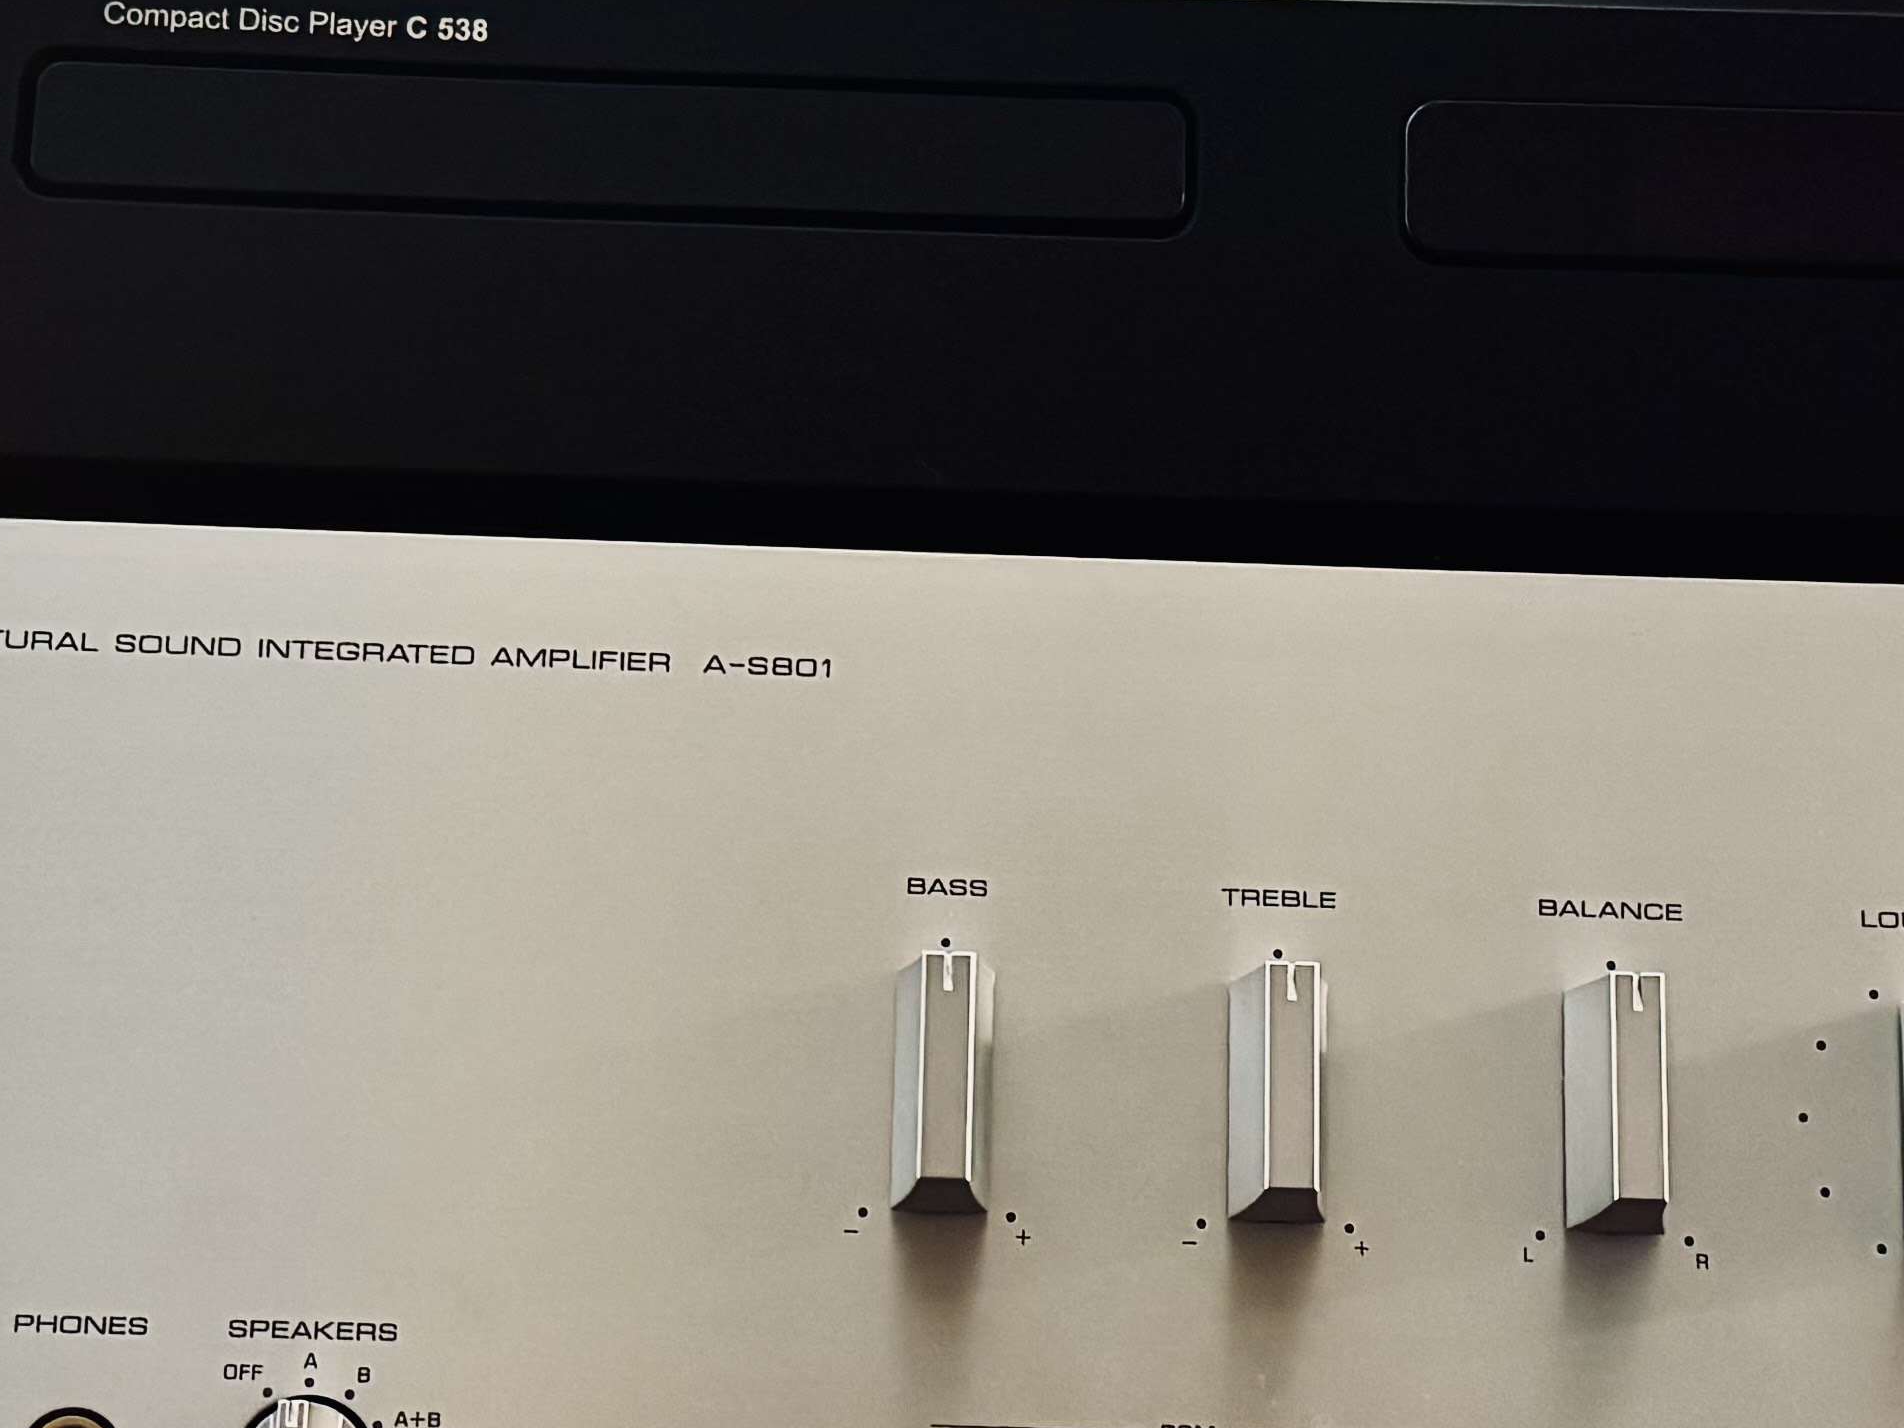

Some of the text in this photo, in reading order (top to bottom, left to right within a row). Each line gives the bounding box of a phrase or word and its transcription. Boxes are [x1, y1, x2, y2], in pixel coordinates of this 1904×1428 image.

[103, 0, 488, 43] Compact Disc Player C 538
[114, 633, 242, 657] SOUND
[258, 638, 475, 665] INTEGRATED
[490, 646, 671, 673] AMPLIFIER
[703, 654, 831, 679] A-S801
[906, 876, 988, 897] BASS
[1221, 888, 1337, 910] TREBLE
[1538, 898, 1683, 922] BALANCE
[1523, 1246, 1534, 1263] L
[1695, 1252, 1709, 1271] R
[13, 1314, 149, 1336] PHONES
[228, 1319, 398, 1342] SPEAKERS
[303, 1352, 318, 1370] A
[223, 1363, 264, 1381] OFF
[357, 1366, 371, 1384] B
[394, 1410, 441, 1428] A+B
